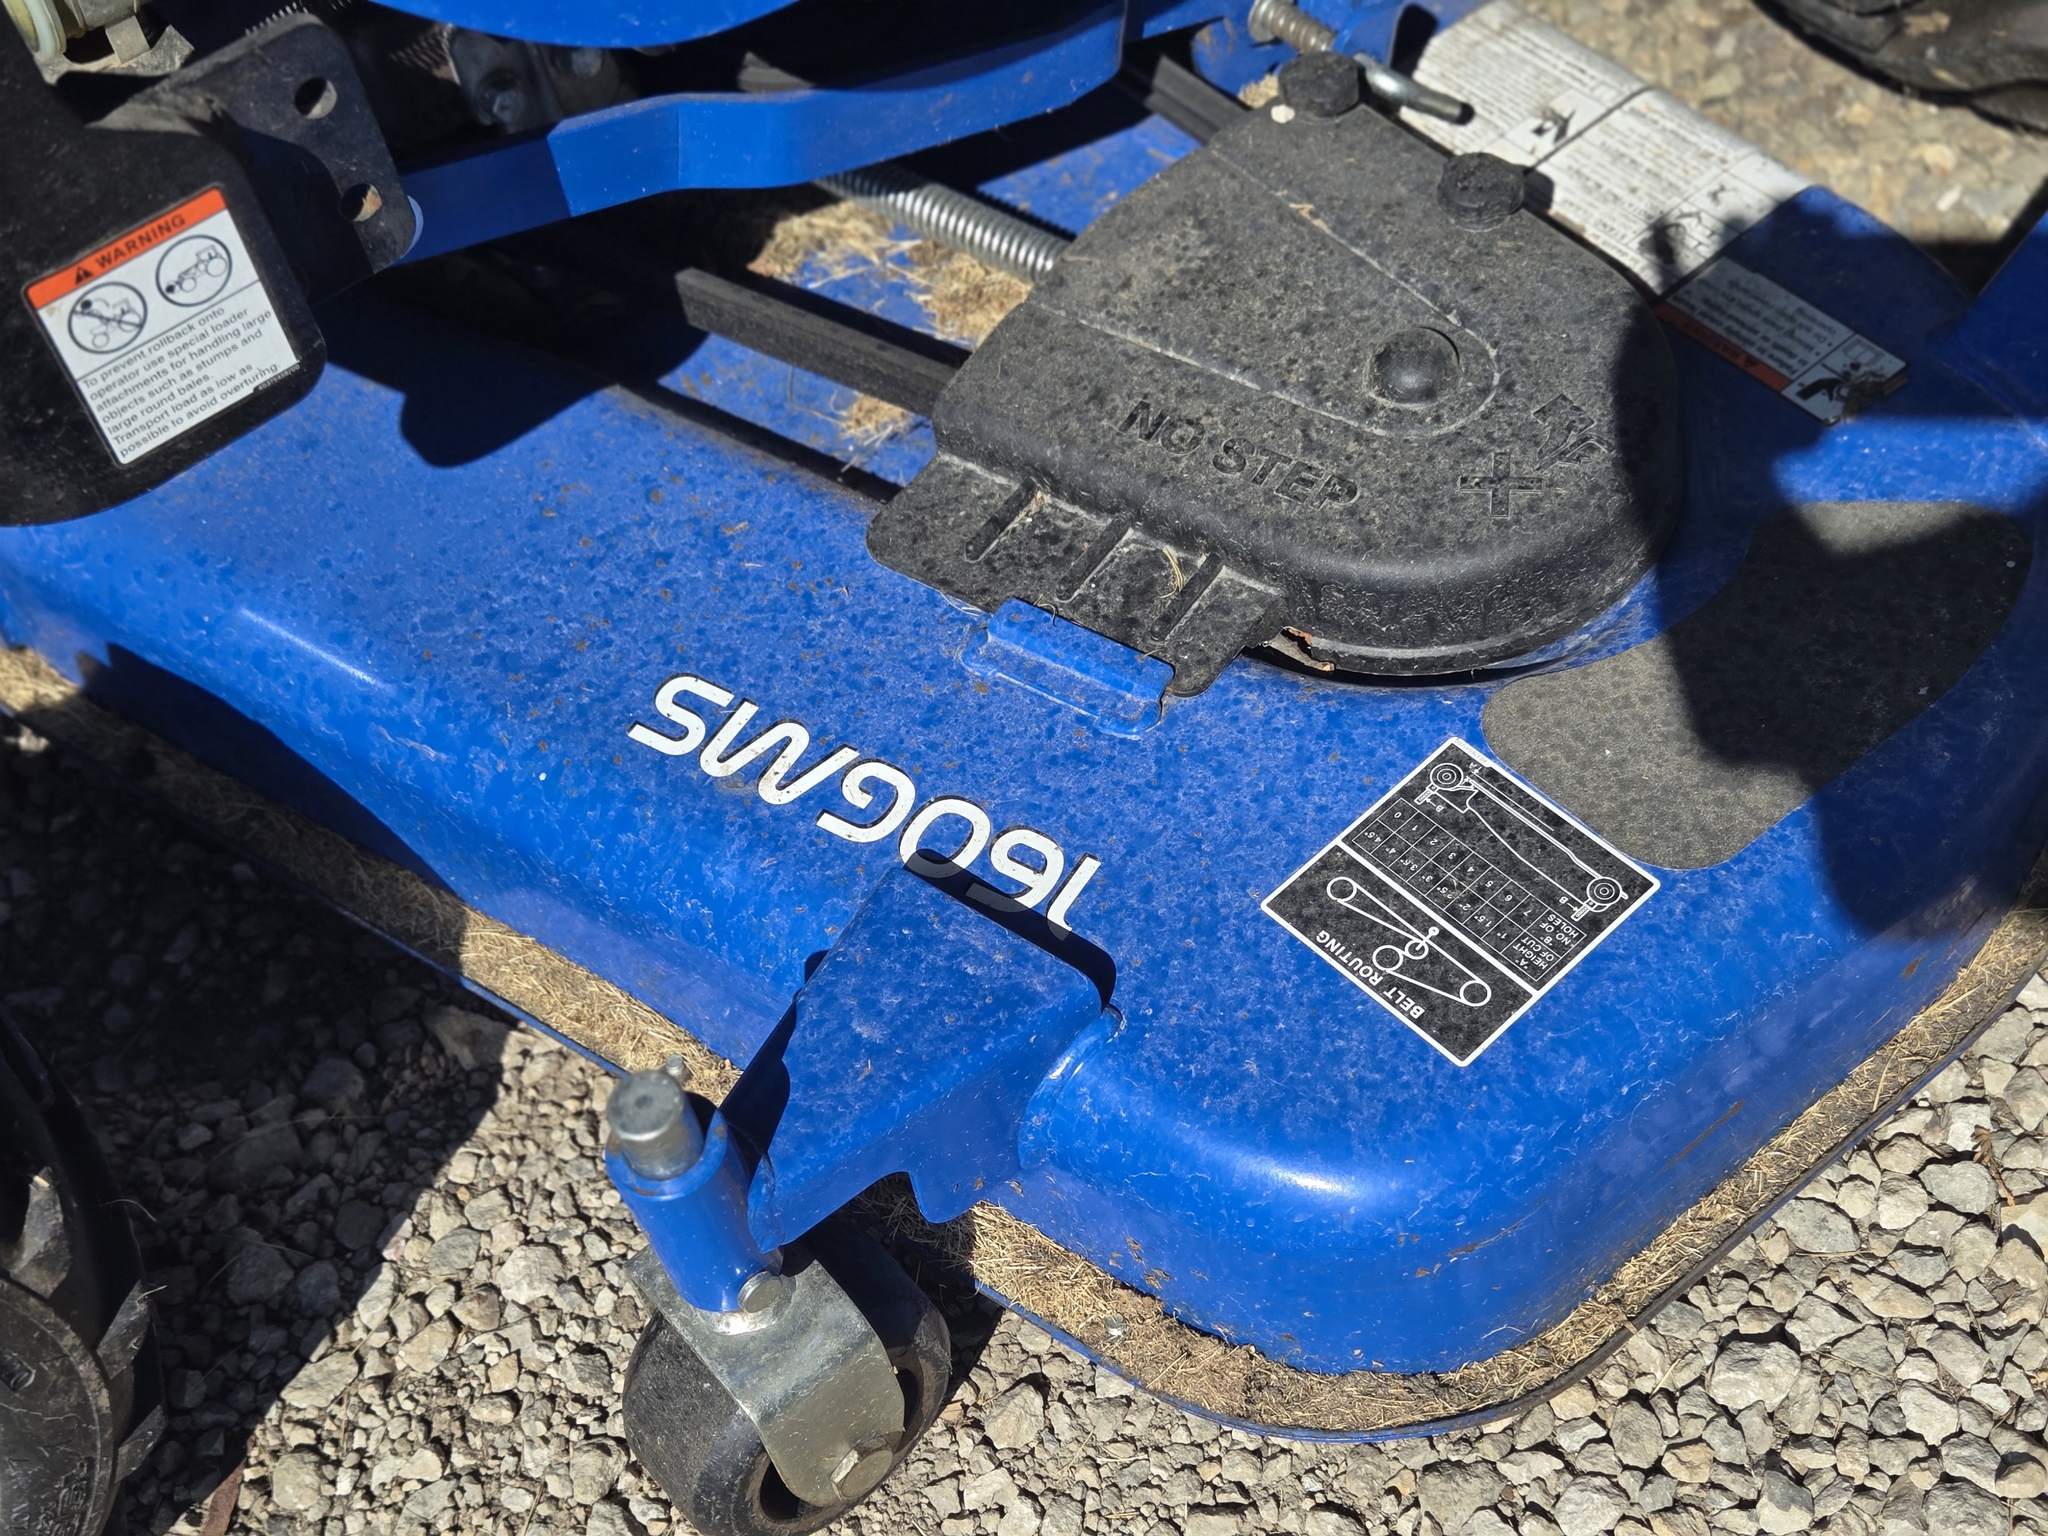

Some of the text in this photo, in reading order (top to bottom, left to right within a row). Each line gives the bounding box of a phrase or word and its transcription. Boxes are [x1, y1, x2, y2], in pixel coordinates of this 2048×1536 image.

[95, 214, 185, 268] WARNING
[83, 307, 224, 388] To prevent rollback onto
[89, 308, 247, 400] operator use special loader
[96, 310, 271, 412] attachments for handling large
[101, 328, 262, 423] objects such as stumps and
[106, 373, 213, 434] large round bales.
[112, 364, 252, 444] Transport load as low as
[119, 424, 169, 458] possible
[170, 416, 183, 427] to
[185, 395, 218, 419] avoid
[1117, 400, 1360, 510] NO STEP
[627, 675, 1101, 941] 160GMS
[1539, 922, 1571, 945] NO. OF
[1547, 913, 1578, 938] HOLES
[1558, 896, 1569, 904] B
[1316, 929, 1424, 1018] BELT ROUTING
[1512, 942, 1548, 969] HEIGHT
[1520, 936, 1554, 961] OF CUT
